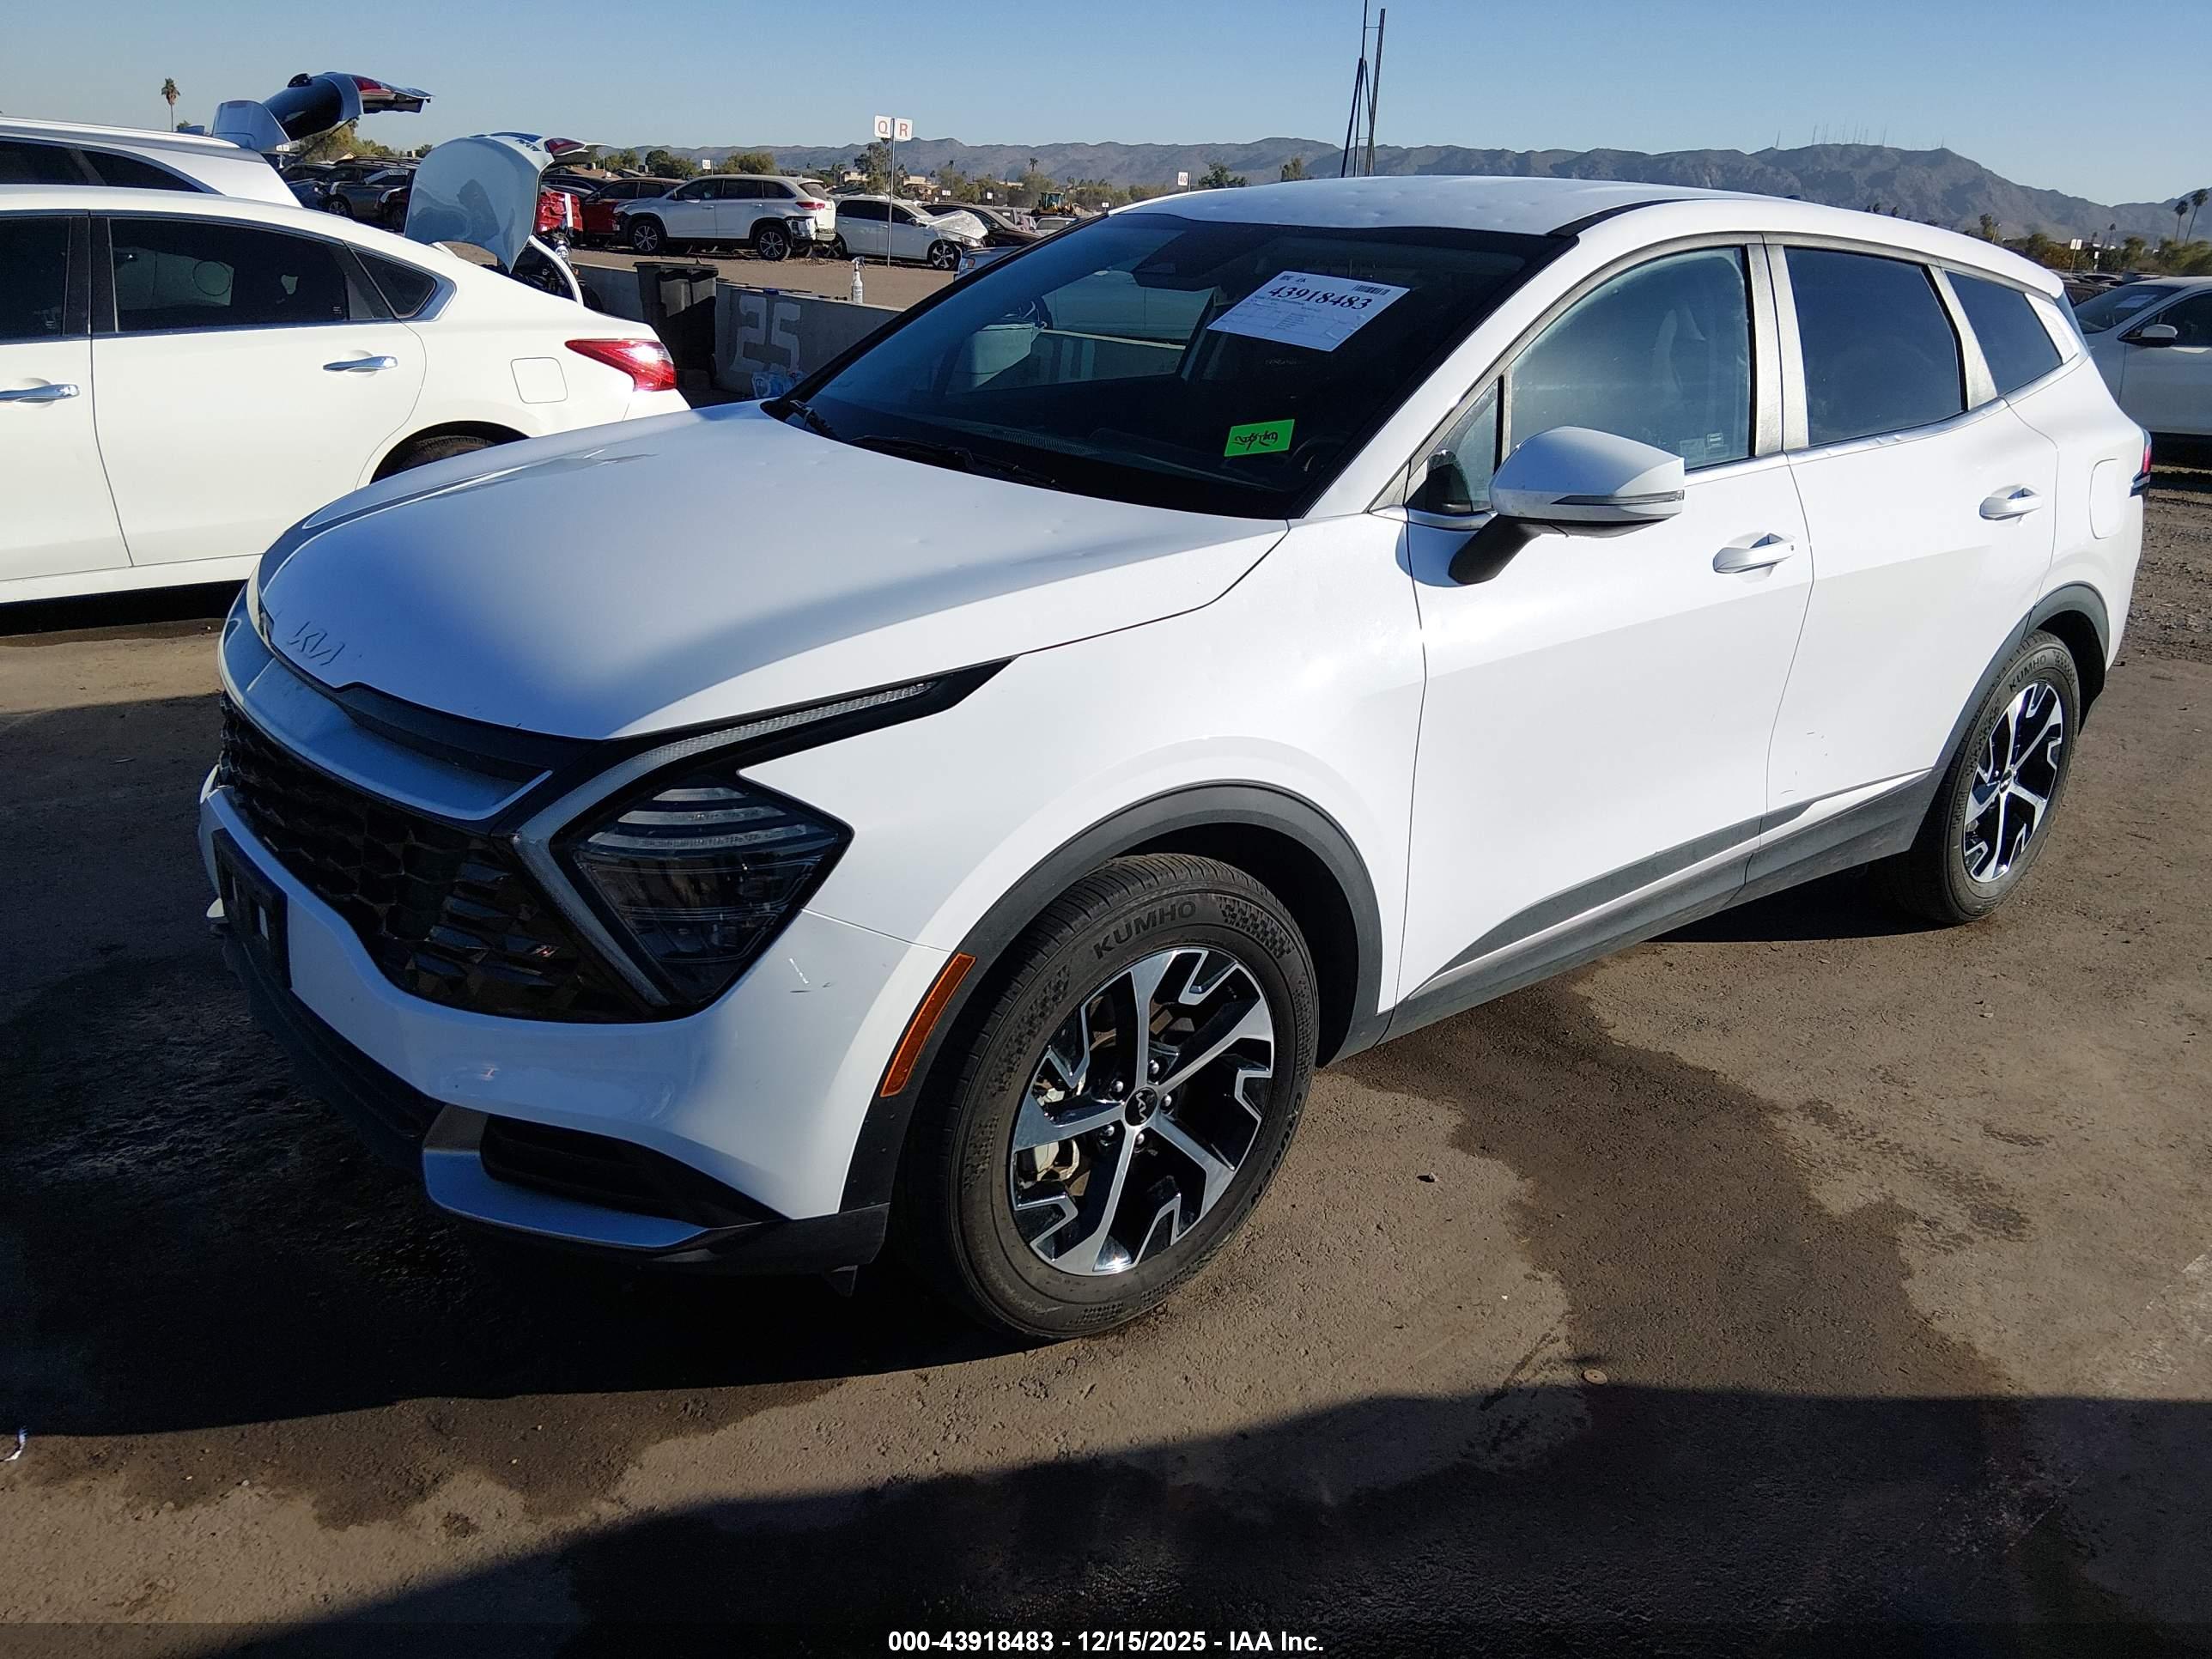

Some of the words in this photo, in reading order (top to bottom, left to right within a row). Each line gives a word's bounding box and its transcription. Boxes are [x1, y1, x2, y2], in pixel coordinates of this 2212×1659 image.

[878, 120, 889, 134] Q
[899, 123, 908, 137] R
[1268, 285, 1375, 310] 43918483
[730, 295, 801, 373] 25
[288, 621, 346, 666] KIA
[2009, 654, 2047, 692] KUMHO
[1092, 900, 1196, 959] KUMHO
